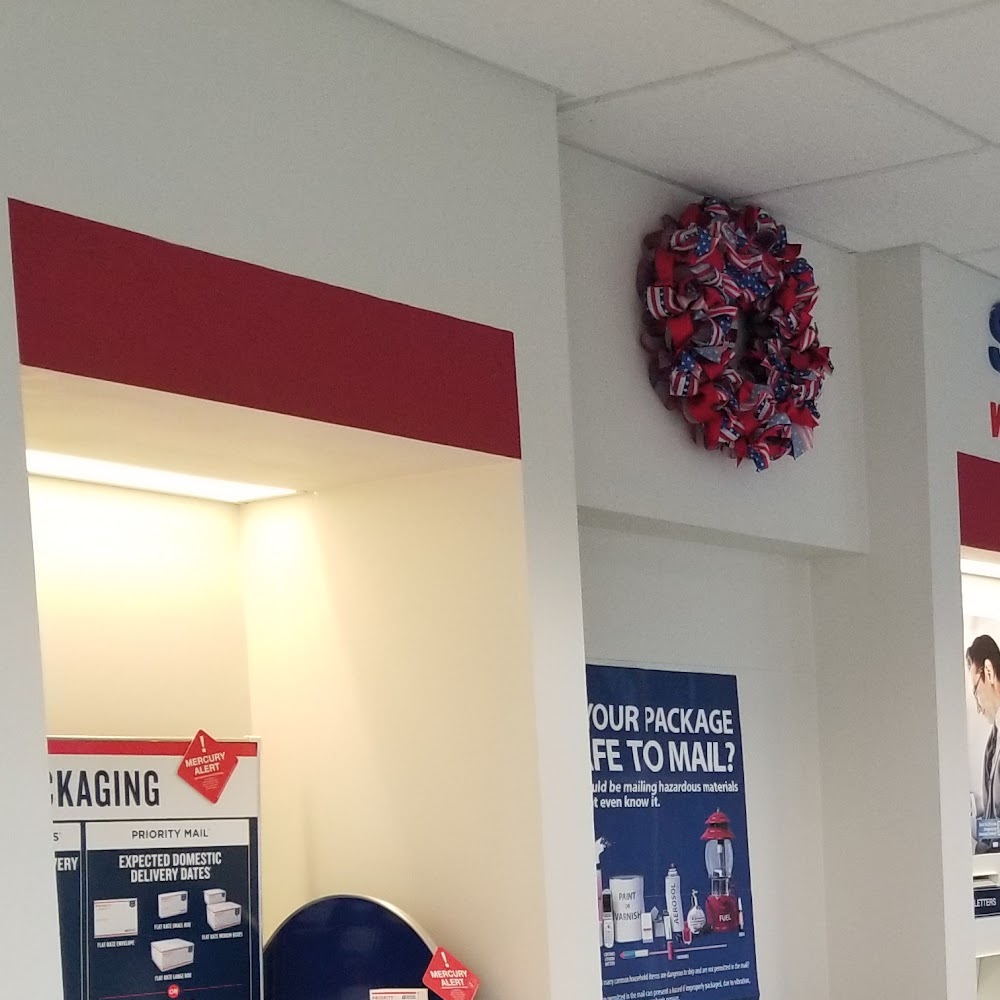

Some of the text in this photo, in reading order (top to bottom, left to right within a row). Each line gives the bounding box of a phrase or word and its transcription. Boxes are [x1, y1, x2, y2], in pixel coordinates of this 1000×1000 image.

[645, 707, 734, 734] PACKAGE
[184, 752, 226, 768] MERCURY
[592, 738, 736, 772] FE TO MAIL?
[194, 762, 220, 775] ALERT
[592, 780, 739, 796] uld be mailing hazardous materials
[600, 798, 622, 808] even
[624, 795, 649, 808] know
[651, 795, 661, 807] it.
[131, 828, 209, 840] PRIORITY MAIL
[119, 851, 222, 869] EXPECTED DOMESTIC
[130, 866, 211, 883] DELIVERY DATES
[618, 891, 636, 901] PAINT
[670, 883, 679, 925] AEROSOL
[718, 913, 732, 922] FUEL
[429, 969, 468, 979] MERCURY
[441, 978, 464, 987] ALERT
